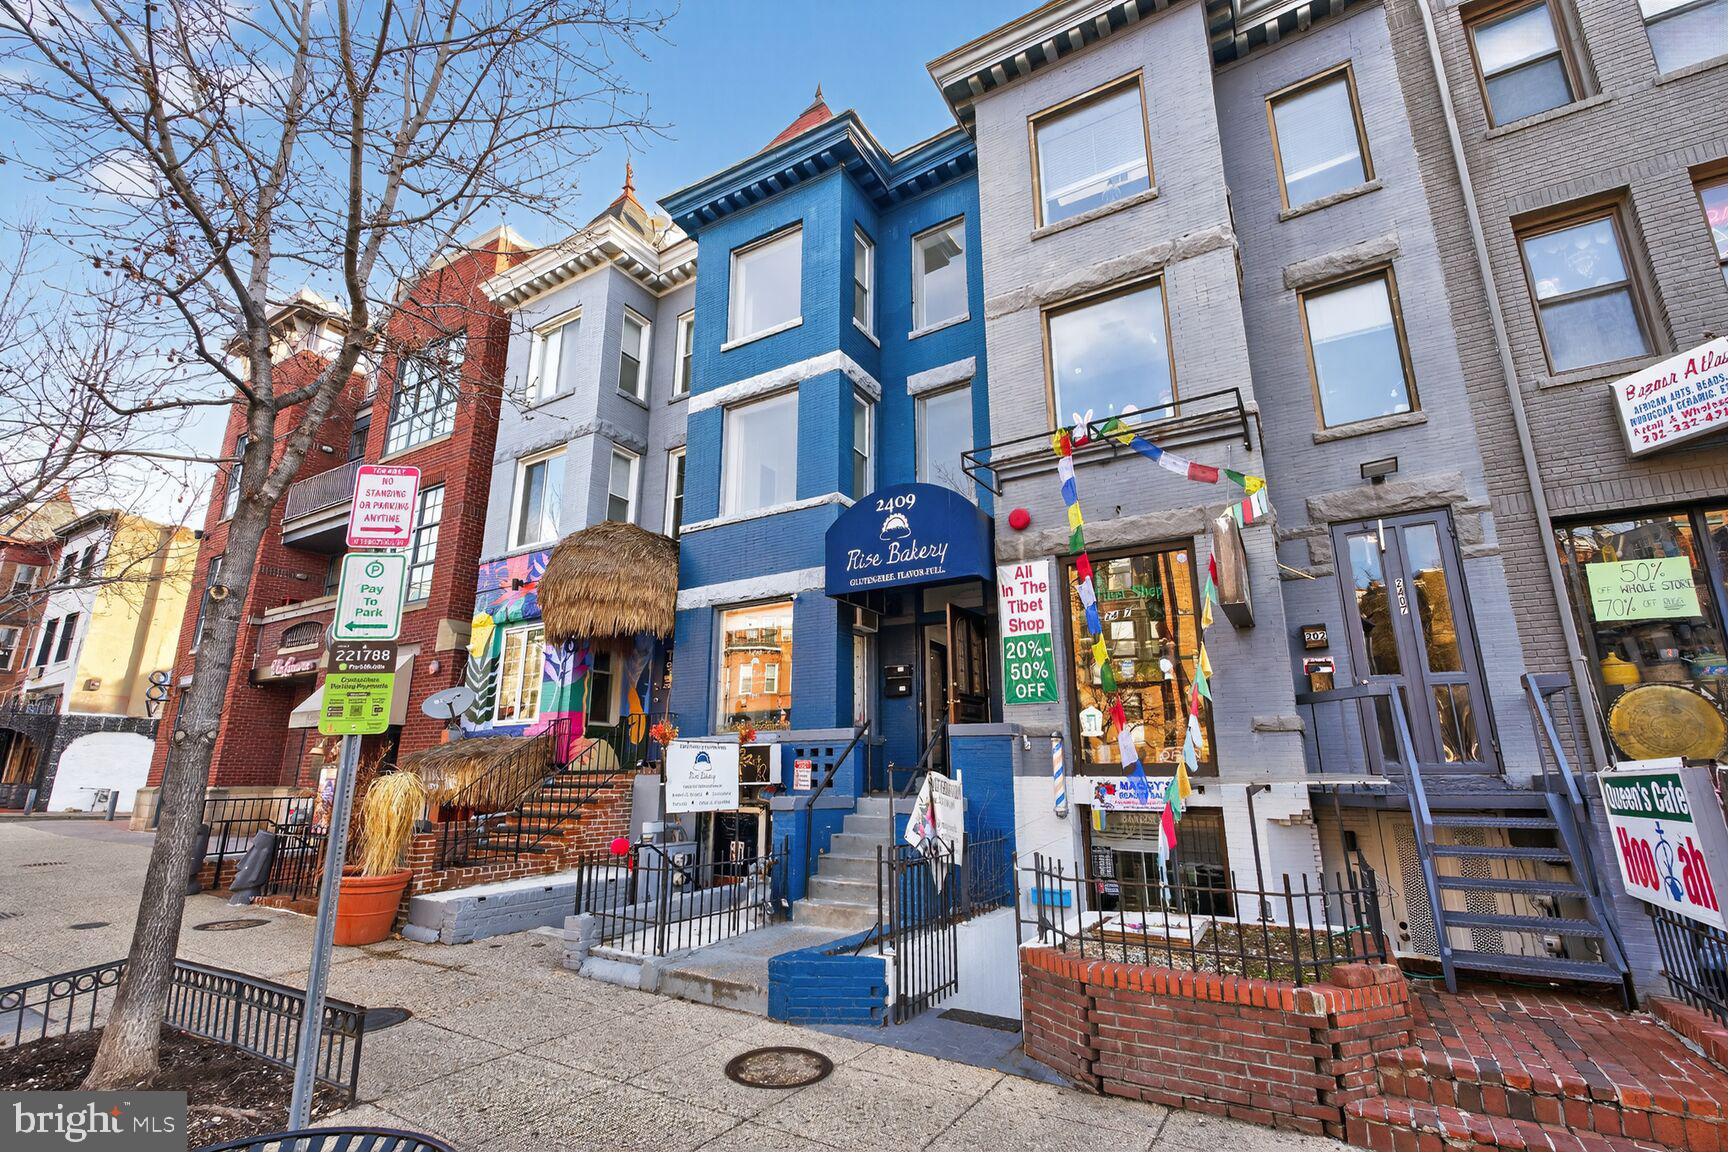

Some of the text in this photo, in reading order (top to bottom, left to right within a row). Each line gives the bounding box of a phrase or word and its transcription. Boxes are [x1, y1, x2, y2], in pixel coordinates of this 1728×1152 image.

[382, 477, 394, 485] NO
[366, 489, 407, 498] STANDING
[359, 501, 410, 510] OR PARKING
[876, 493, 916, 513] 2409
[364, 514, 401, 522] ANYTIME
[846, 539, 949, 571] Rise Bakery
[1014, 565, 1033, 580] All
[1620, 562, 1665, 582] 50%
[360, 584, 384, 595] Pay
[1001, 581, 1047, 597] In The
[1131, 584, 1163, 600] Shop
[1620, 583, 1657, 594] WHOLE
[363, 597, 378, 606] To
[1007, 598, 1044, 614] Tibet
[1597, 597, 1636, 616] 70%
[355, 608, 383, 617] Park
[1009, 618, 1045, 633] Shop
[335, 650, 391, 661] 221788
[1006, 640, 1051, 659] 20%-
[1010, 661, 1049, 680] 50%
[1015, 683, 1046, 698] OFF
[1605, 780, 1689, 815] Queen's Cafe
